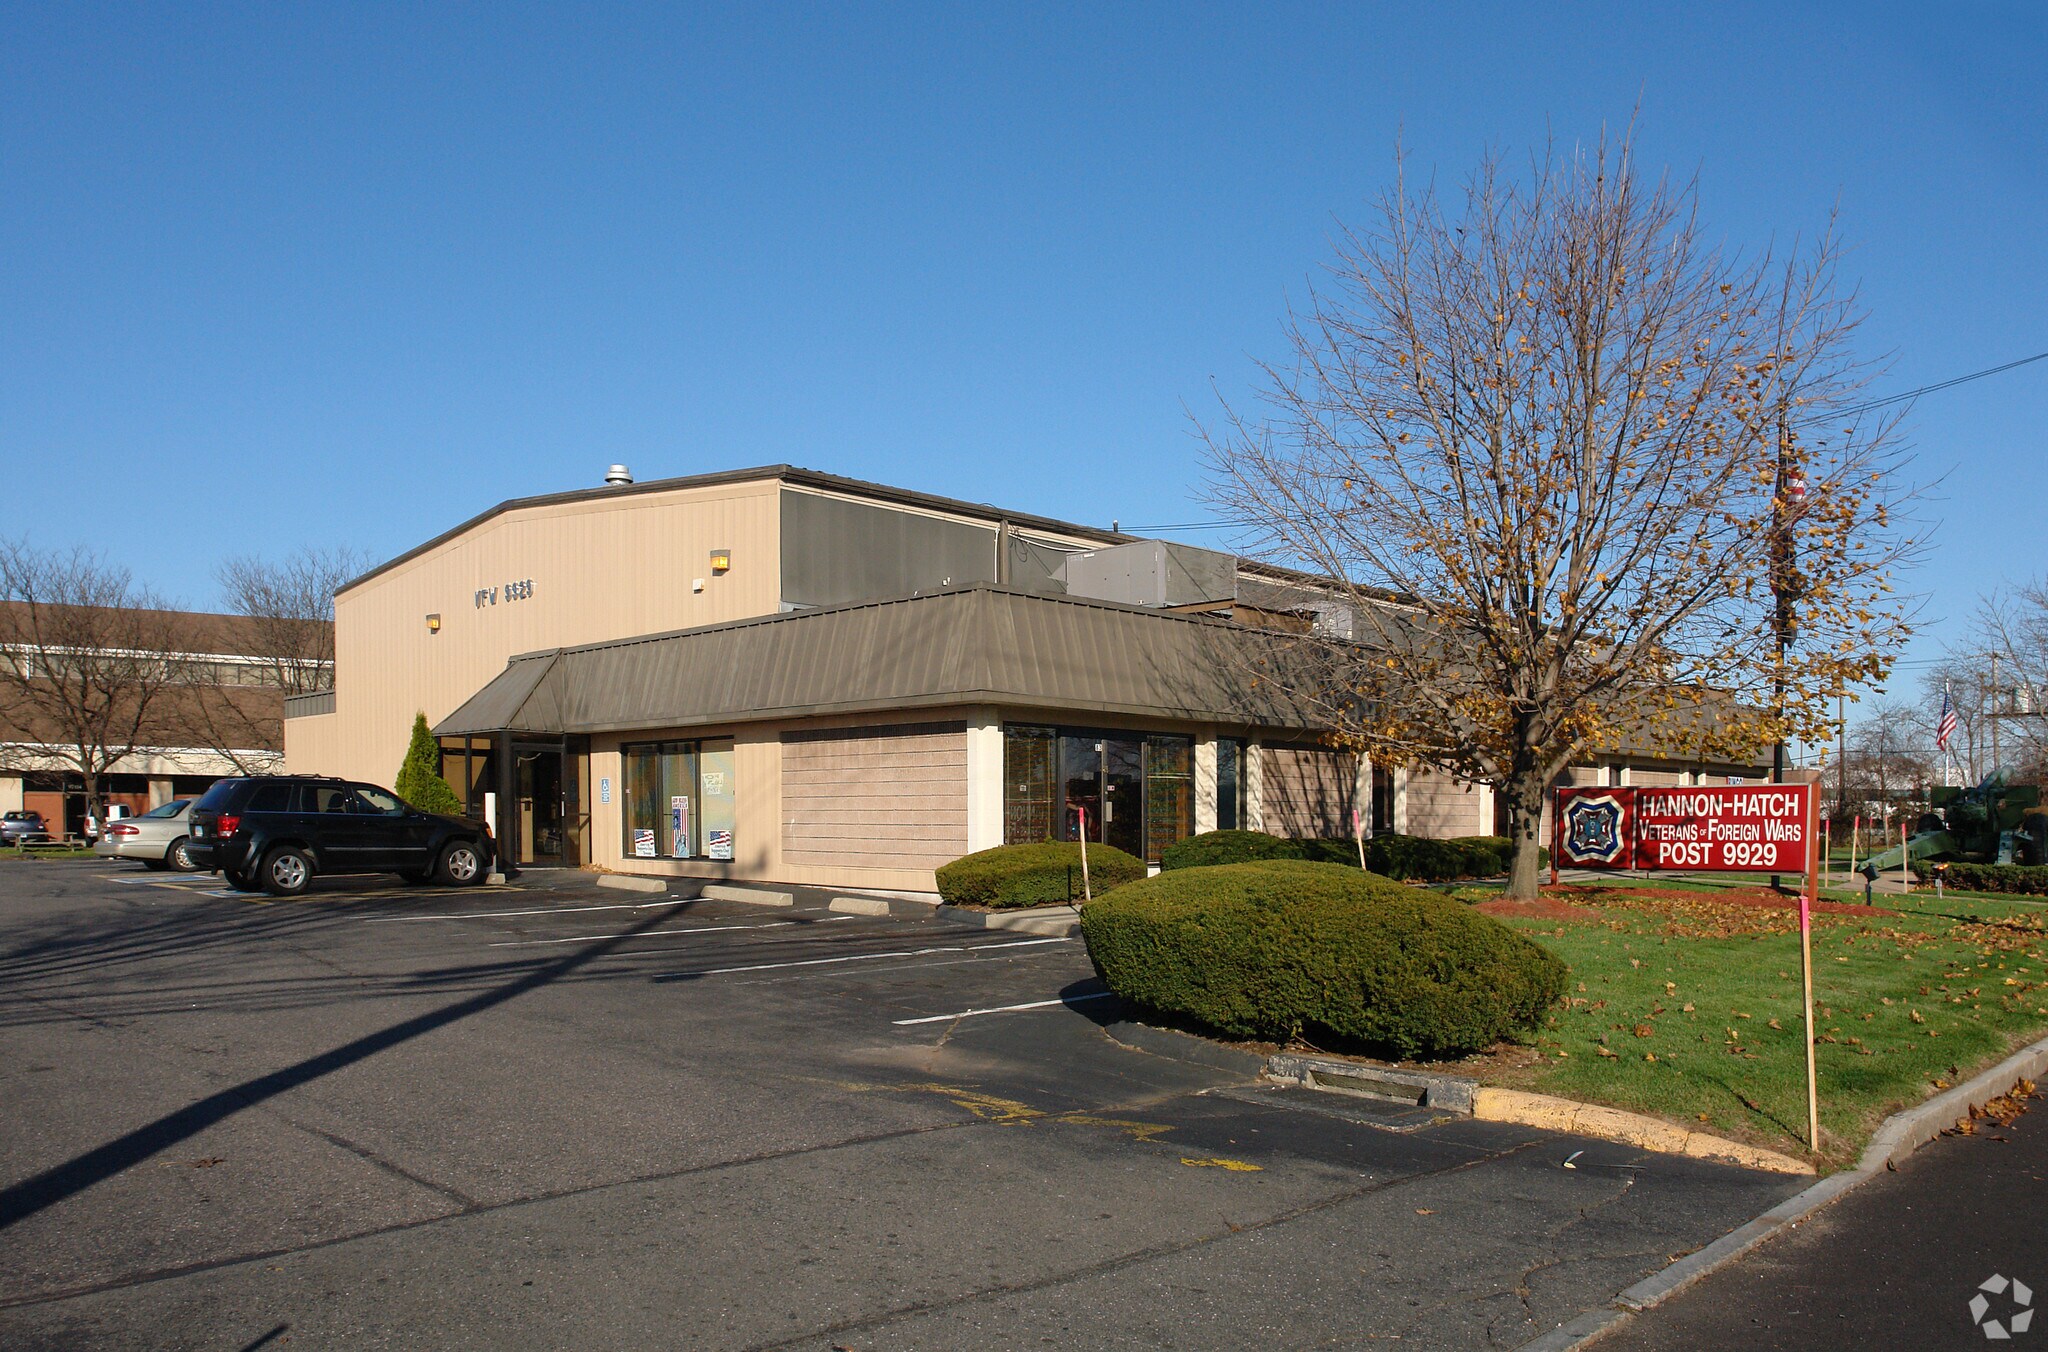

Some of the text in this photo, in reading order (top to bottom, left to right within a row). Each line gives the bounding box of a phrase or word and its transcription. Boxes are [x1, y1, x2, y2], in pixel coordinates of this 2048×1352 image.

[1642, 794, 1799, 817] HANNON-HATCH
[1700, 828, 1707, 836] OF
[1659, 842, 1777, 866] POST 9929
